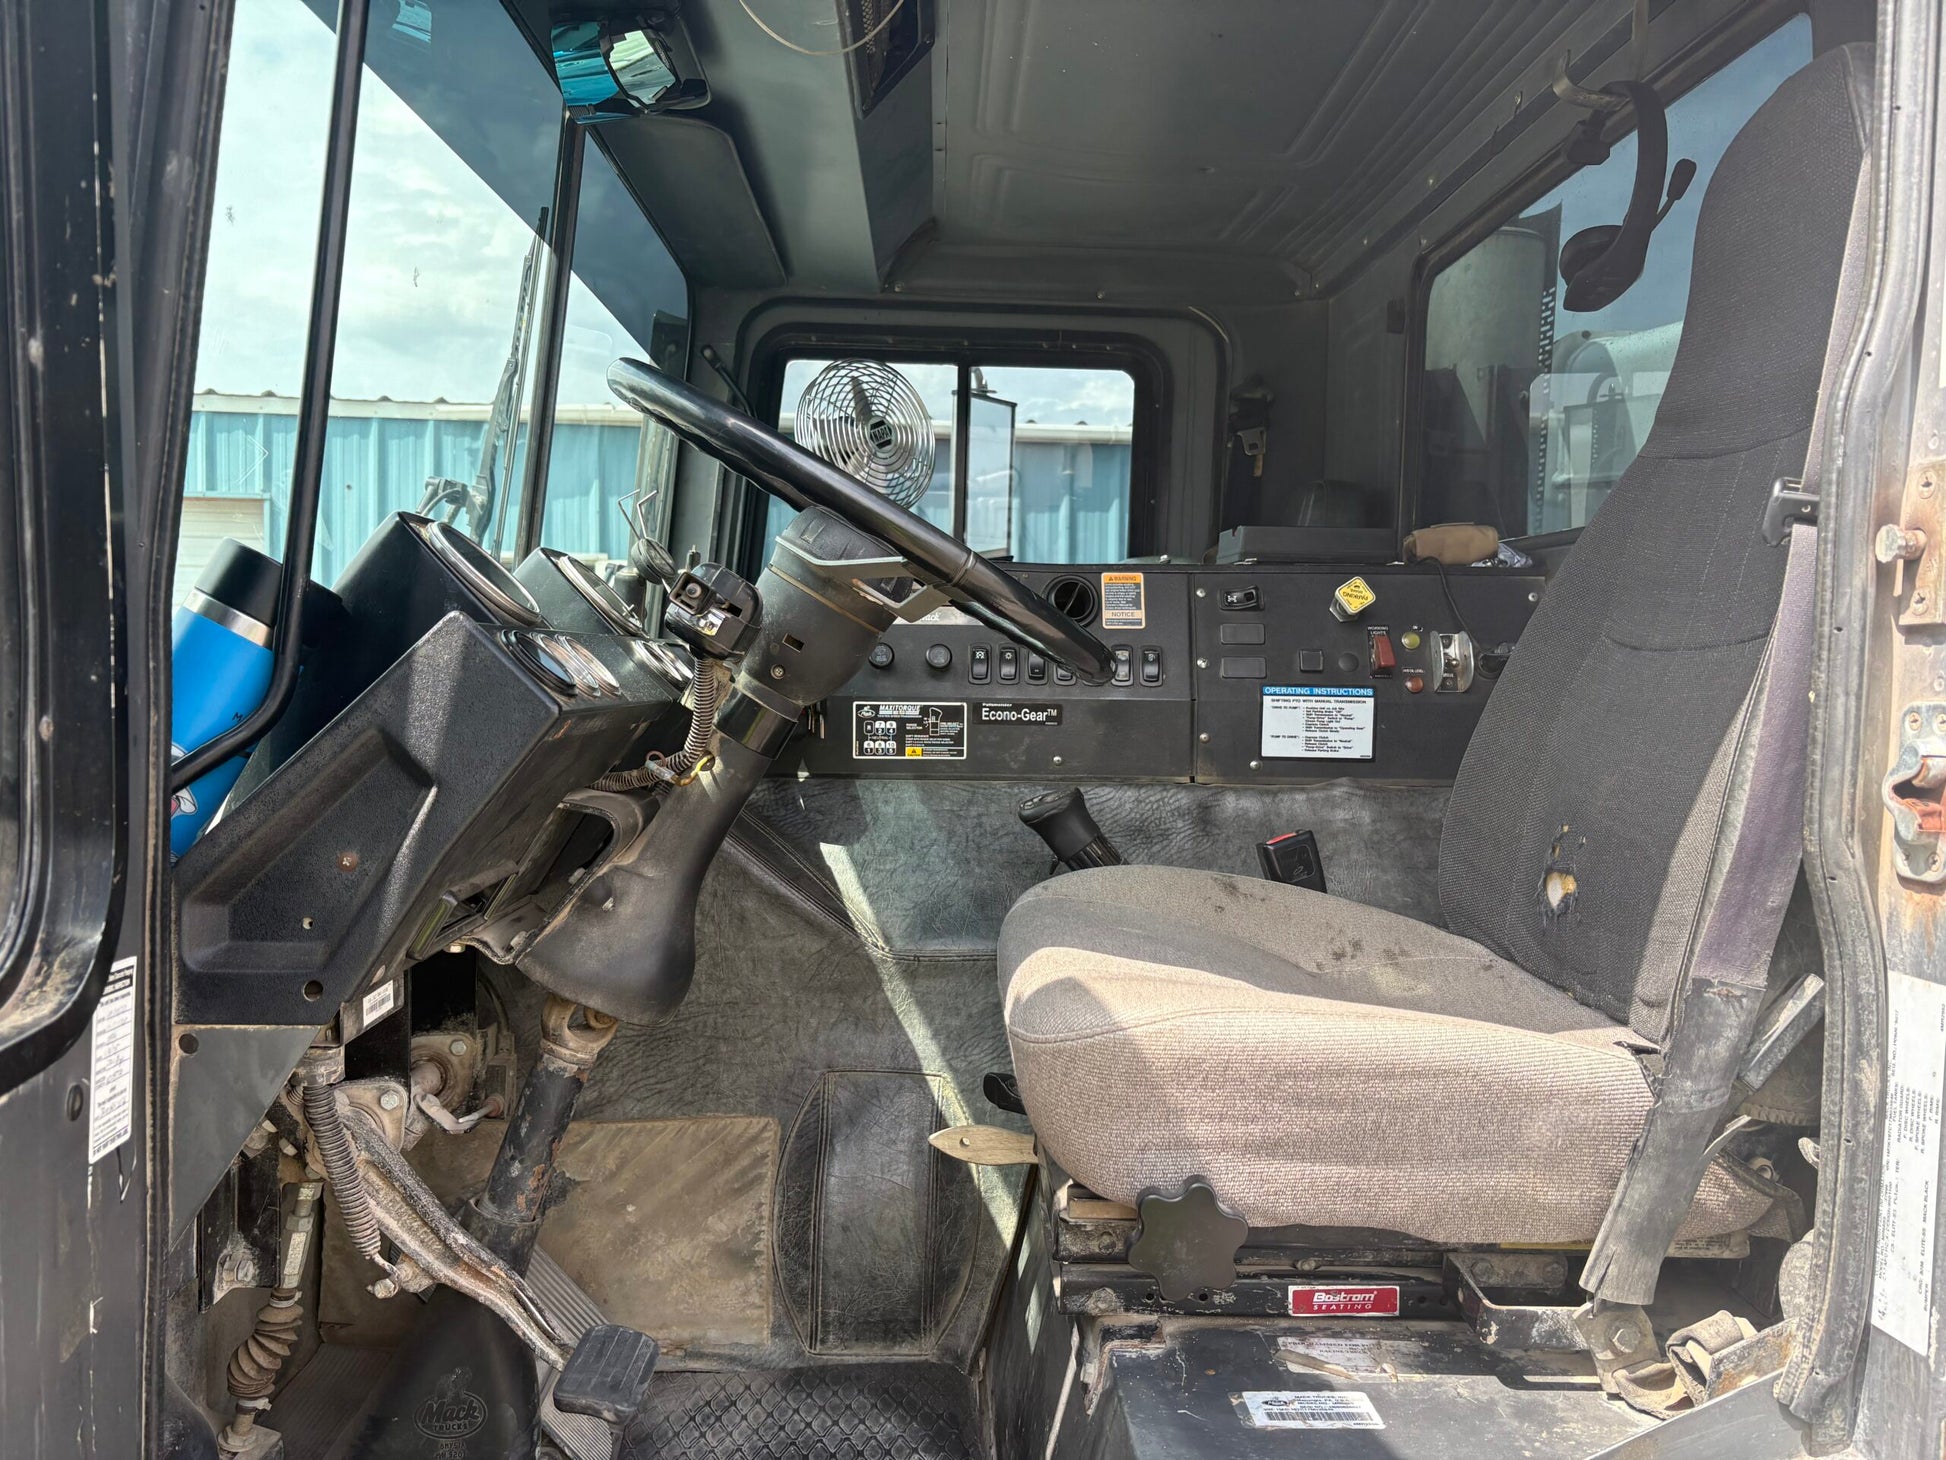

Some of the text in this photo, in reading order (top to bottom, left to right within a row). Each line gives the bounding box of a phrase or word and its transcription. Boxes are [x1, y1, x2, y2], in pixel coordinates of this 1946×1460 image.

[871, 426, 892, 444] NAPA
[1313, 1292, 1374, 1302] Bostrom
[421, 1398, 480, 1424] Mack
[434, 1423, 468, 1432] TRUCKS
